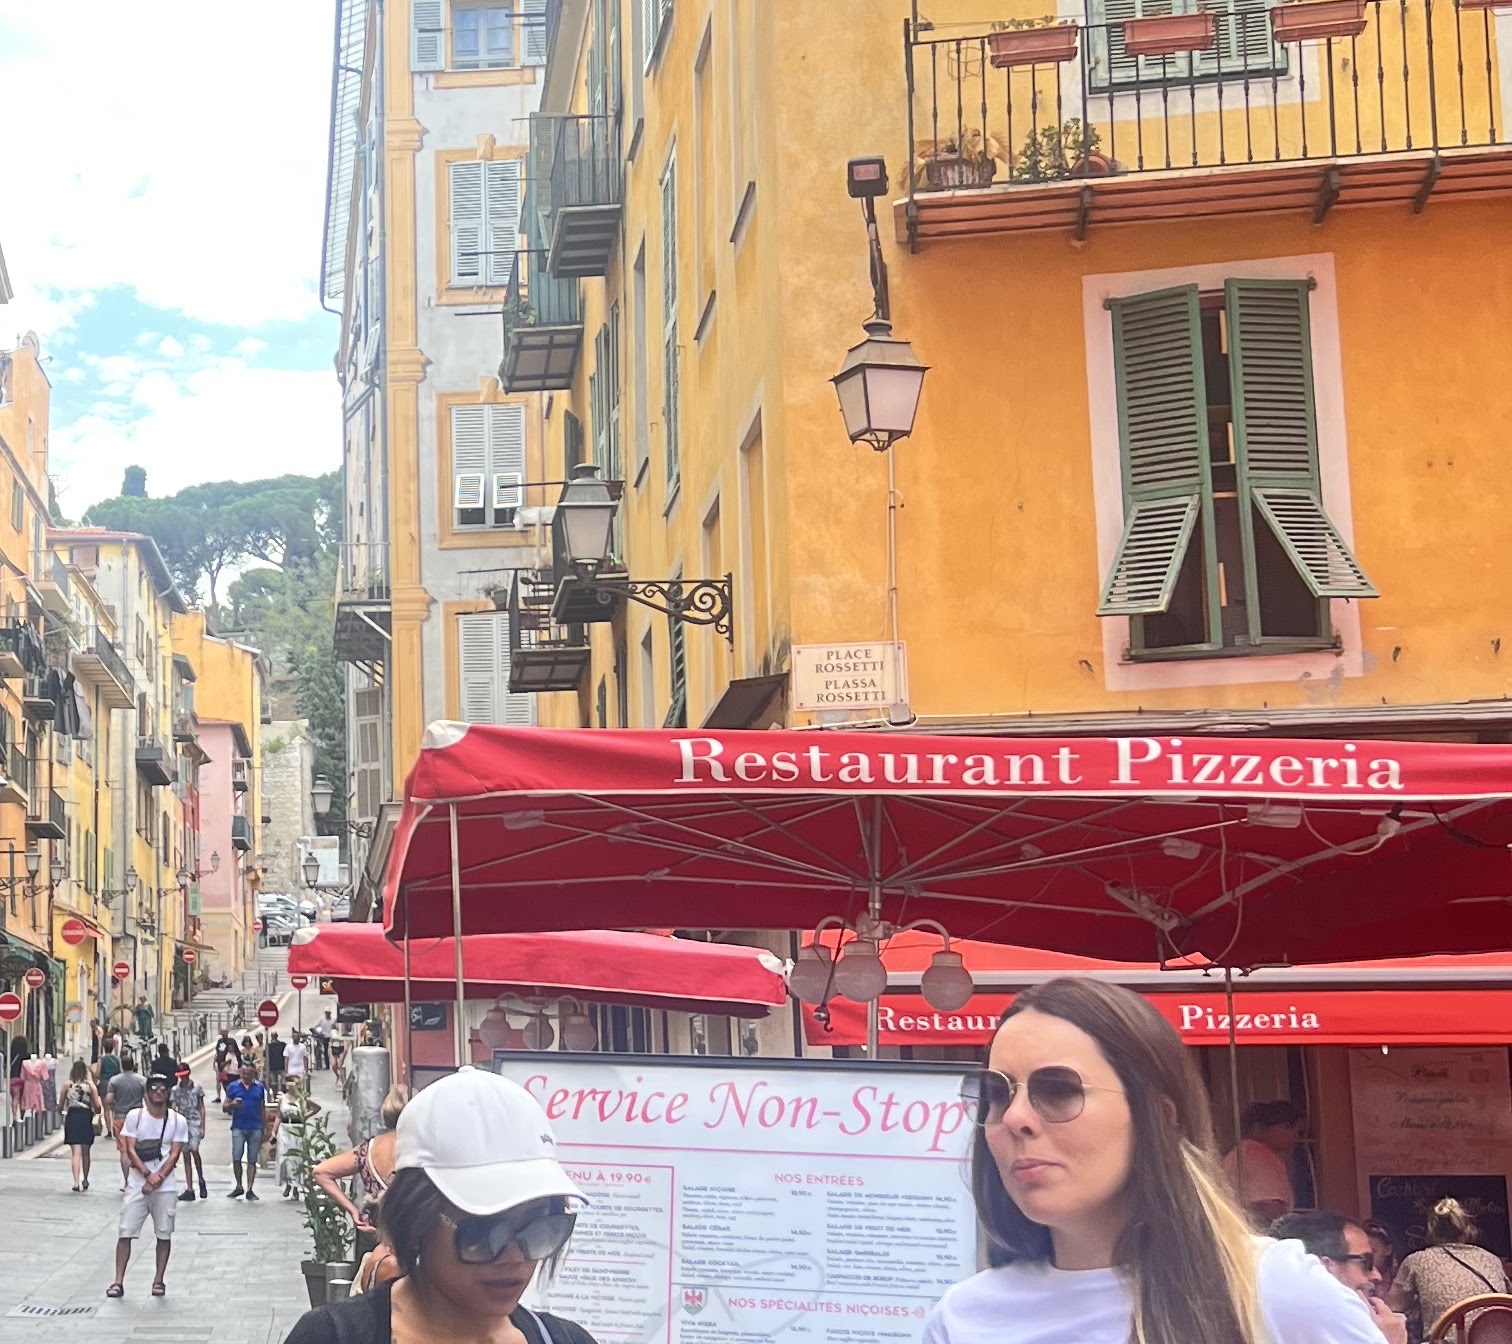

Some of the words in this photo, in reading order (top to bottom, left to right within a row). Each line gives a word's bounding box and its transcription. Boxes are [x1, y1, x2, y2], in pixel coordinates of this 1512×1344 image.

[826, 648, 872, 660] PLACE
[815, 660, 884, 674] ROSSETTI
[824, 678, 877, 690] PLASSA
[816, 690, 886, 703] ROSSETTI
[670, 738, 1083, 786] Restaurant
[1108, 737, 1405, 790] Pizzeria
[878, 1006, 1001, 1032] Restaur
[1180, 1004, 1319, 1030] Pizzeria
[522, 1074, 689, 1125] Service
[704, 1080, 974, 1152] Non-Stop
[566, 1170, 592, 1181] ENU
[774, 1174, 802, 1184] NOS
[806, 1174, 865, 1186] ENTRÉES
[728, 1298, 756, 1309] NOS
[760, 1298, 842, 1312] SPÉCIALITÉS
[846, 1304, 909, 1317] NIÇOISES
